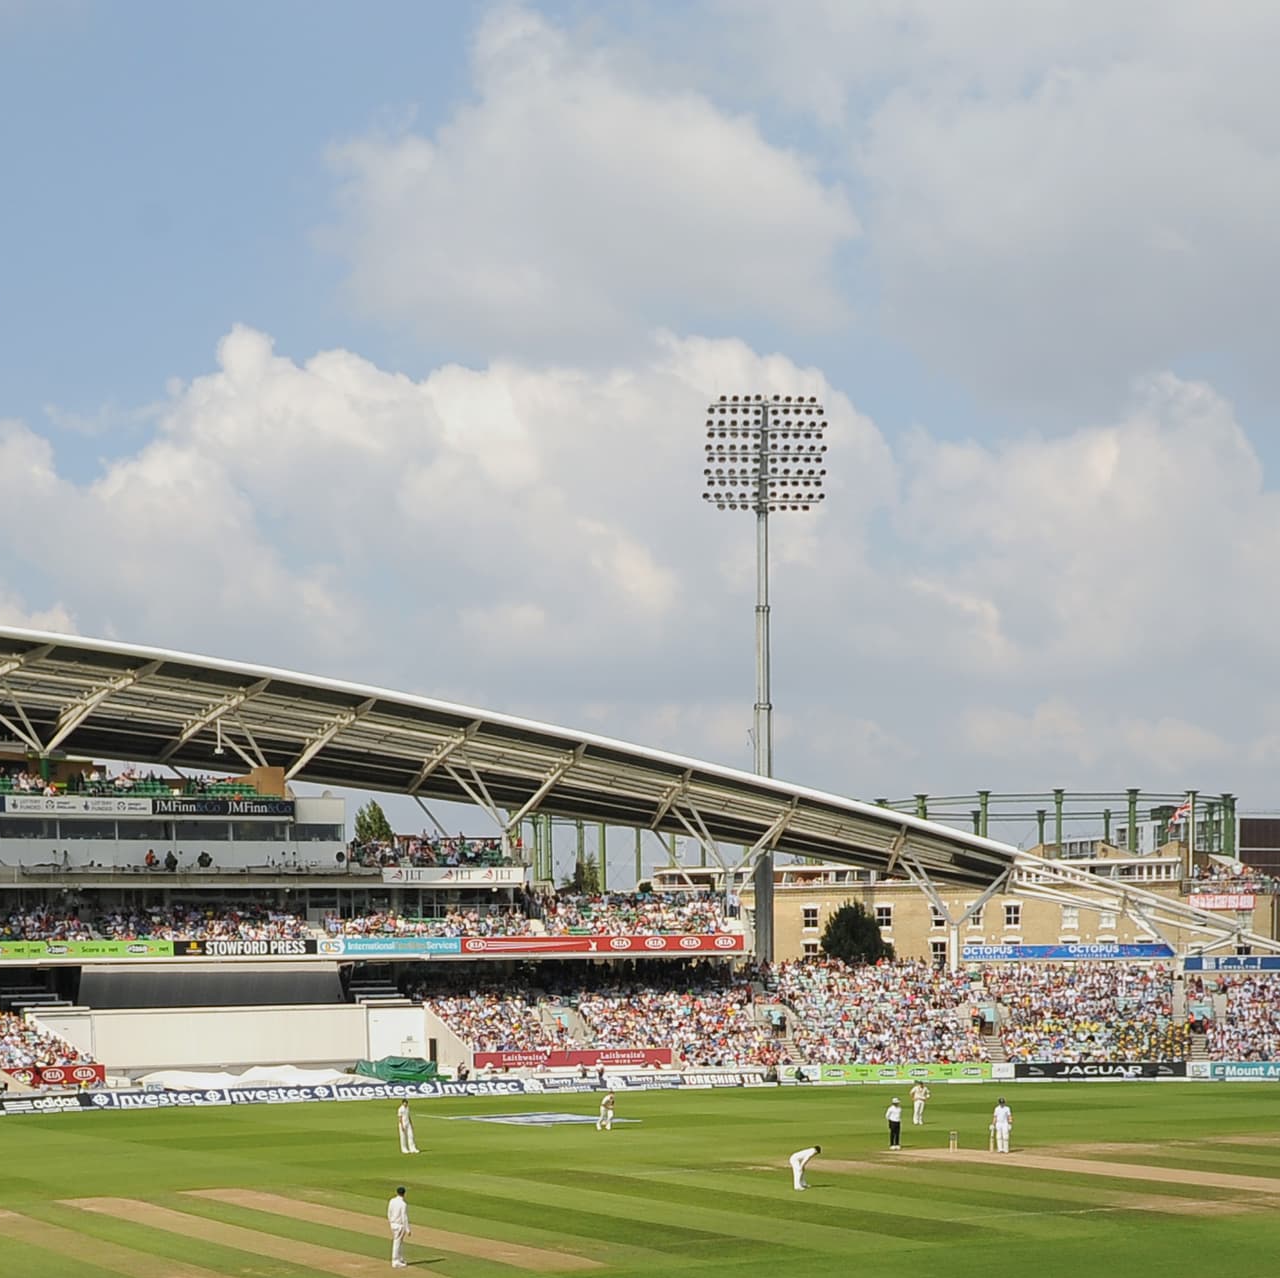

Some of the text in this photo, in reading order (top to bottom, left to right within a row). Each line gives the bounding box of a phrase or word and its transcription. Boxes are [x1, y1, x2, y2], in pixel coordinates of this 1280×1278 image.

[205, 940, 306, 955] STOWFORD PRESS
[426, 940, 459, 950] Services
[467, 940, 485, 950] KIA
[613, 939, 630, 947] KIA
[648, 939, 664, 947] KIA
[683, 938, 699, 946] KIA
[718, 938, 734, 946] KIA
[963, 945, 1013, 956] OCTOPUS
[1069, 944, 1119, 954] OCTOPUS
[44, 1070, 62, 1080] KIA
[76, 1068, 93, 1079] KIA
[1057, 1065, 1143, 1076] JAGUAR
[1226, 1065, 1265, 1077] Mount
[683, 1073, 764, 1085] YORKSHIRE TEA
[223, 1085, 312, 1102] Investec
[333, 1082, 415, 1100] Investec
[436, 1080, 520, 1096] Investec
[33, 1095, 80, 1110] adidas
[112, 1090, 202, 1107] Investec
